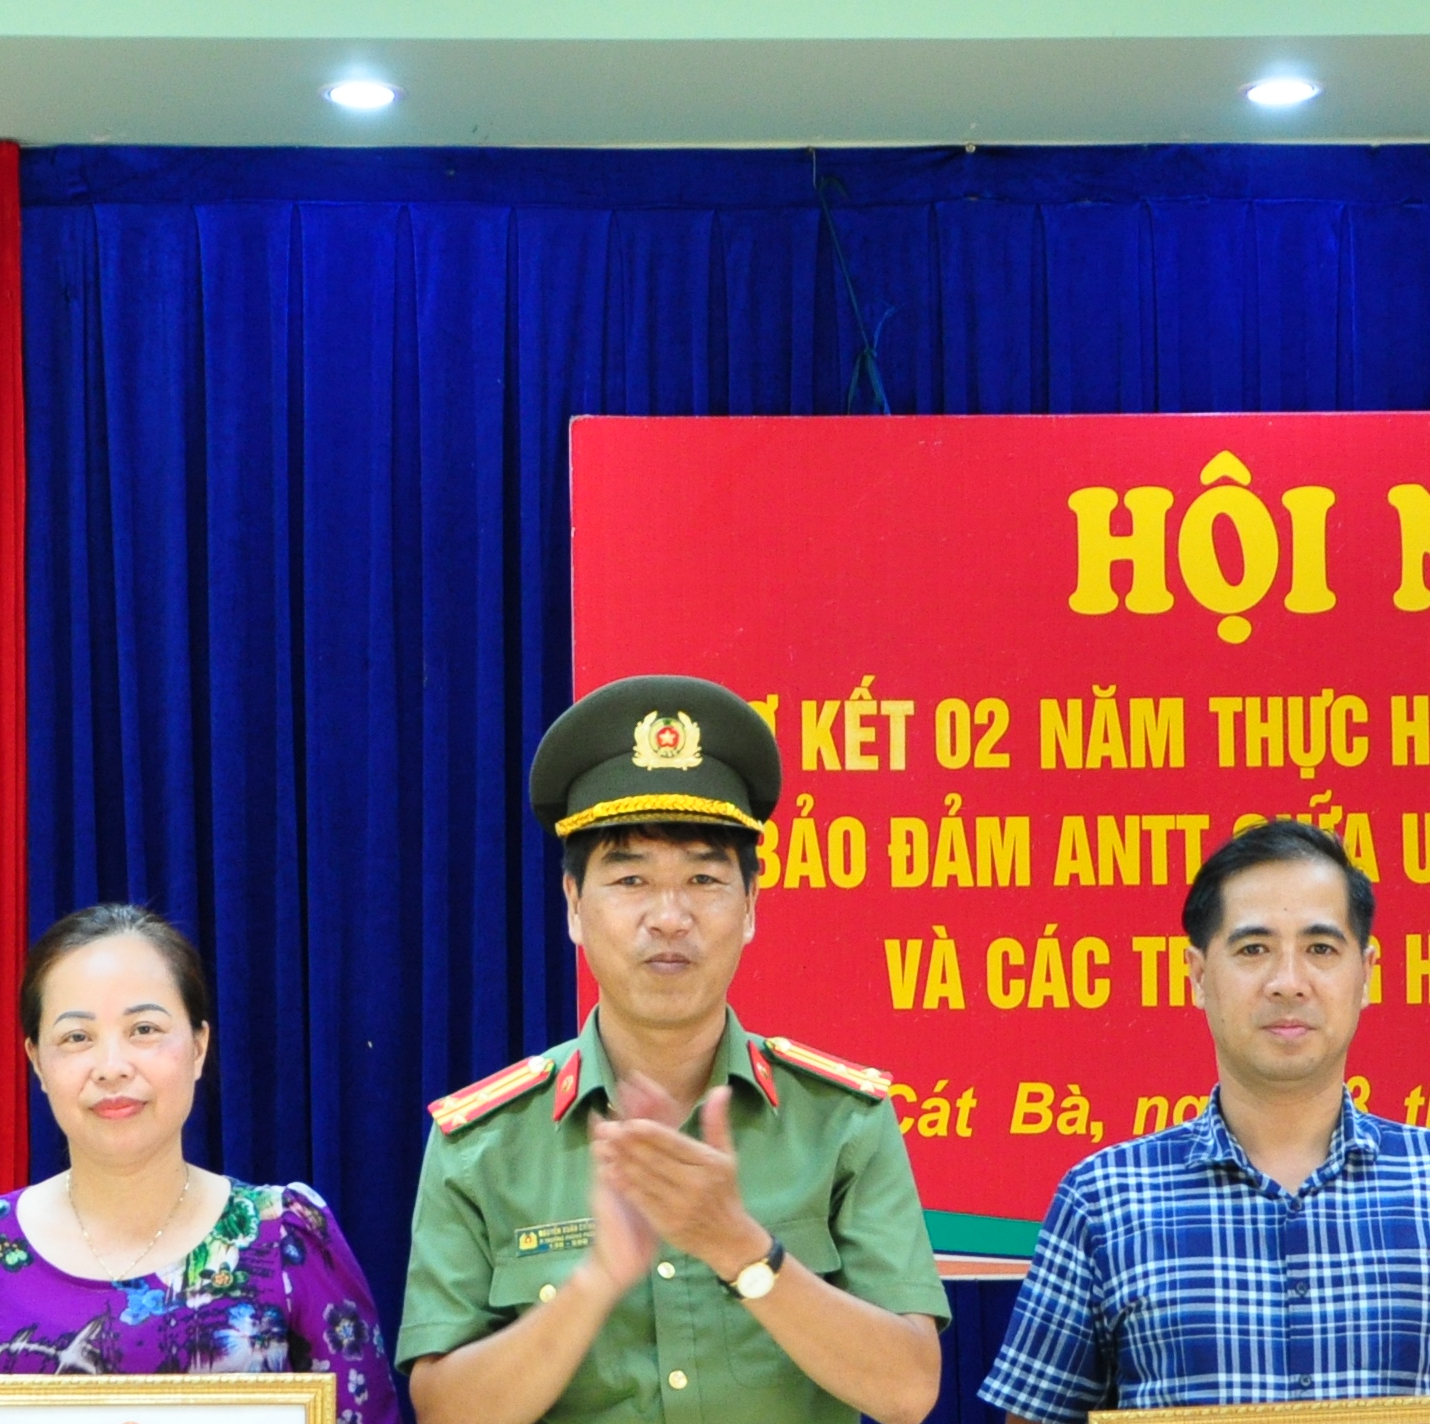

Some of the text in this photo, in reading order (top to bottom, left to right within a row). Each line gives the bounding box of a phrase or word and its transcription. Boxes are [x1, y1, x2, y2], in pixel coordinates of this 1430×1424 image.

[1067, 450, 1337, 645] HỘI
[801, 675, 915, 771] KẾT
[935, 697, 1011, 770] 02
[1040, 684, 1185, 770] NĂM
[1208, 688, 1369, 780] THỰC
[887, 792, 1031, 888] ĐẢM
[1053, 814, 1210, 887] ANTT
[884, 925, 966, 1010] VÀ
[986, 923, 1111, 1010] CÁC
[1009, 1082, 1104, 1143] Bà,
